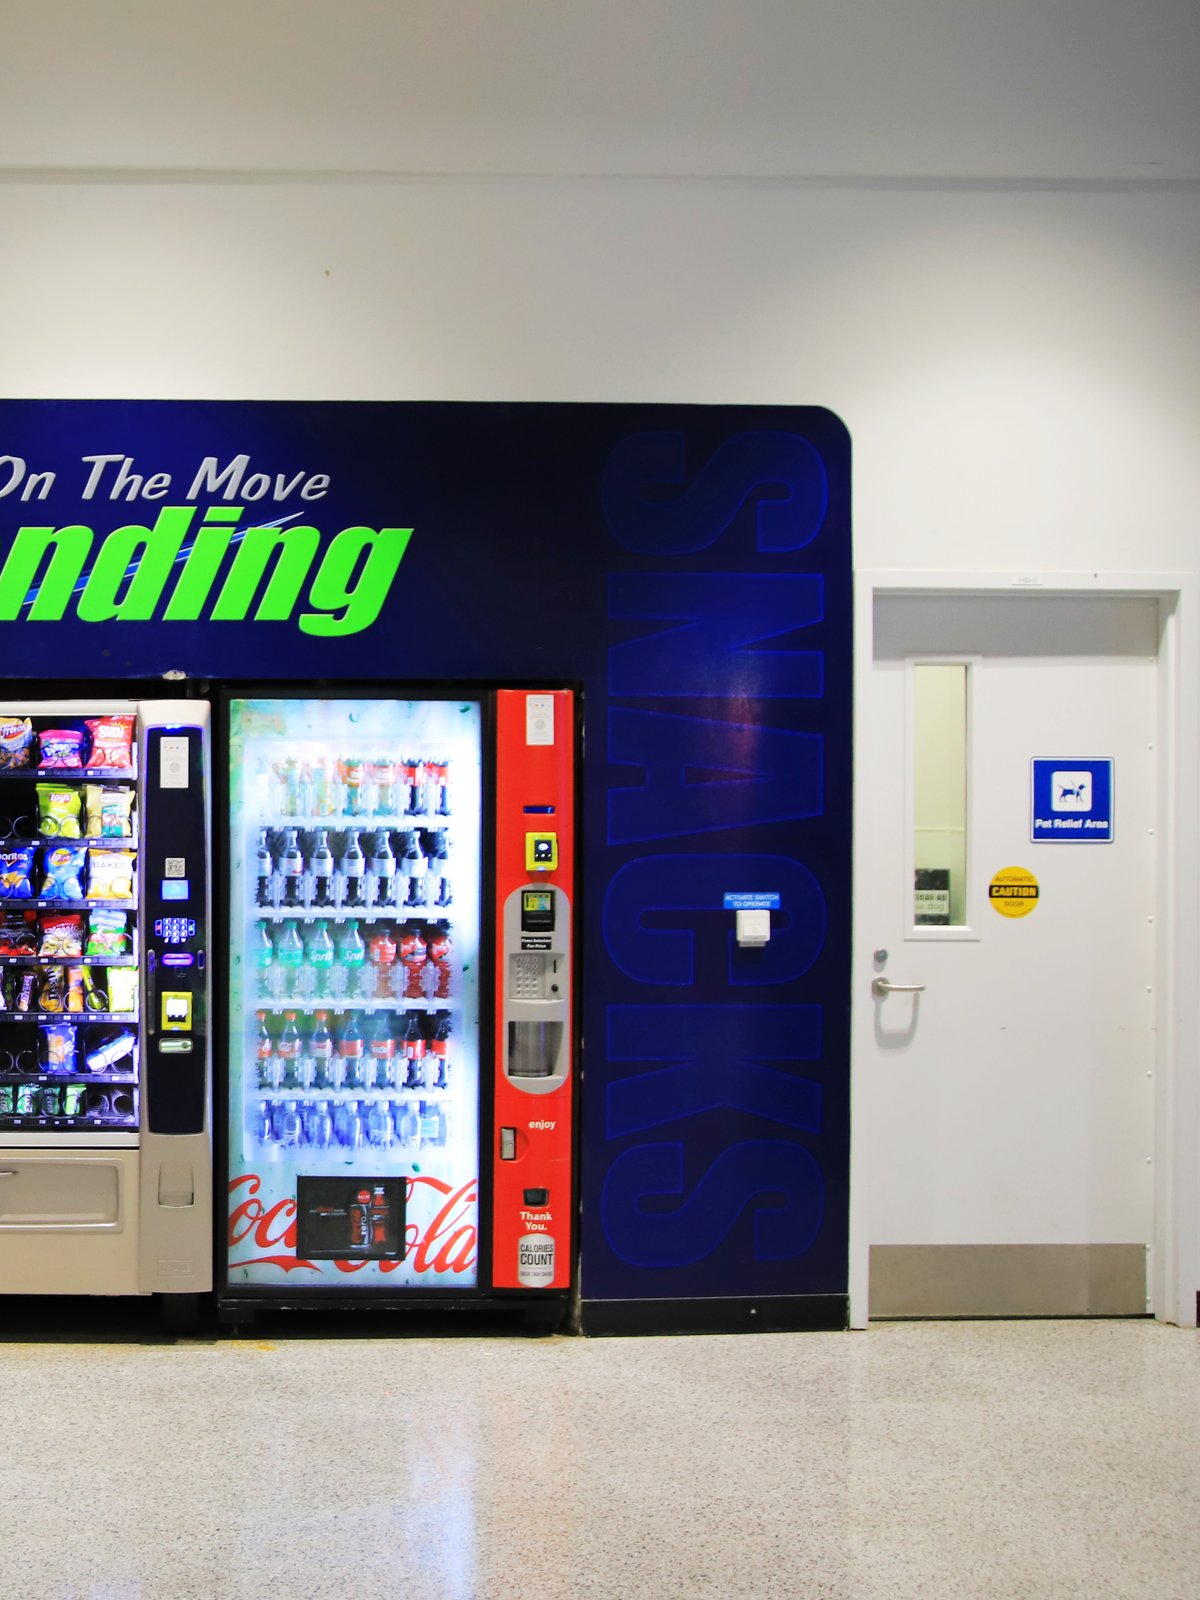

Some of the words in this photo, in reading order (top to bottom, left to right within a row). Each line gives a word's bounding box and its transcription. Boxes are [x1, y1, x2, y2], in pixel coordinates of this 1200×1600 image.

[81, 454, 172, 501] The
[185, 454, 331, 502] Move
[1034, 818, 1052, 829] Pet
[1054, 818, 1083, 829] Relief
[1084, 818, 1109, 829] Area
[601, 429, 828, 1269] SNACKS
[991, 886, 1037, 897] CAUTION
[528, 1119, 556, 1130] enjoy
[520, 1211, 553, 1221] Thank
[525, 1221, 548, 1231] You.
[520, 1243, 554, 1253] CALORIES
[520, 1253, 554, 1266] COUNT
